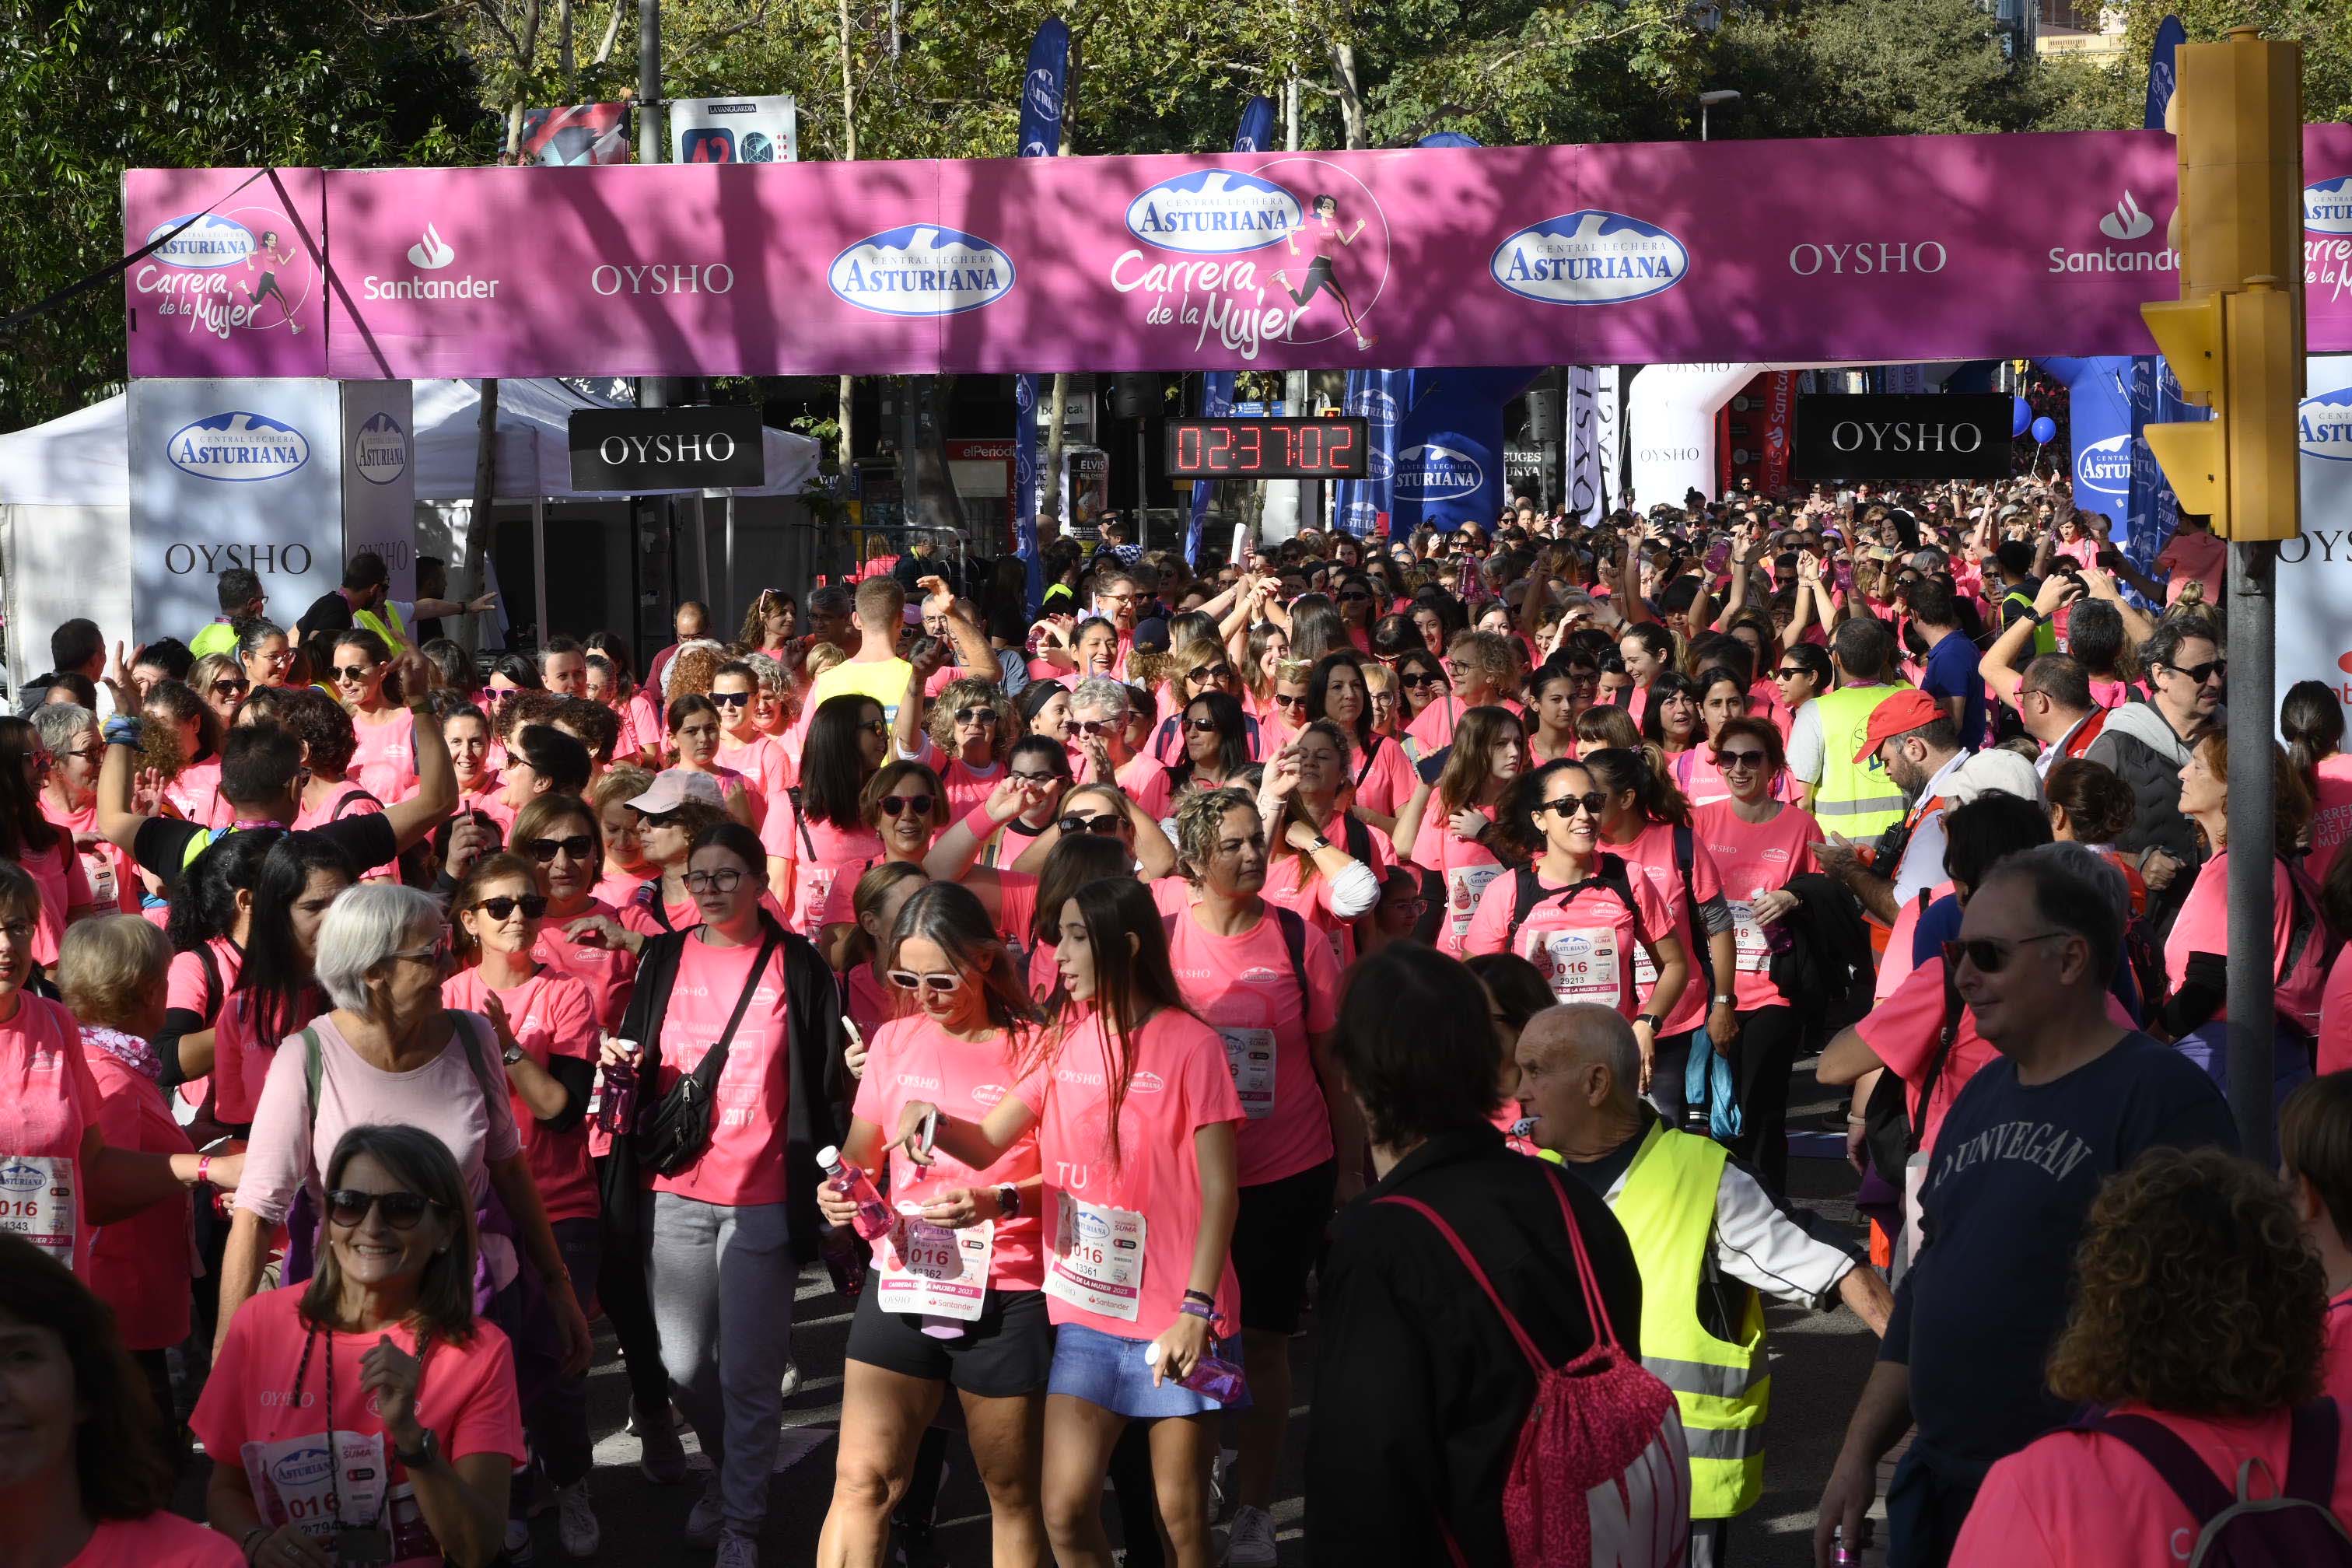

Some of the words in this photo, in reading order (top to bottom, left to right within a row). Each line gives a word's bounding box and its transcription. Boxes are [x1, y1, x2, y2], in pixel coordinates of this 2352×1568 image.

[1167, 197, 1222, 208] CENTRAL
[1227, 196, 1284, 207] LECHERA
[1139, 201, 1286, 233] ASTURIANA
[154, 233, 247, 255] ASTURIANA
[1536, 243, 1597, 253] CENTRAL
[1604, 242, 1667, 251] LECHERA
[871, 256, 929, 265] CENTRAL
[936, 254, 994, 264] LECHERA
[1505, 247, 1674, 281] ASTURIANA
[1789, 240, 1947, 275] OYSHO
[2048, 246, 2181, 274] Santande
[136, 264, 228, 294] Carrera
[590, 263, 735, 296] OYSHO
[843, 258, 1000, 292] ASTURIANA
[1111, 249, 1258, 293] Carrera
[363, 275, 499, 299] Santander
[159, 295, 177, 315] de
[180, 294, 191, 315] la
[189, 291, 262, 340] Mujer
[1146, 295, 1174, 325] de
[1179, 293, 1199, 325] la
[1195, 285, 1311, 360] Mujer
[1178, 426, 1353, 470] 02:37:02
[1832, 421, 1983, 453] OYSHO
[179, 437, 299, 464] ASTURIANA
[359, 439, 404, 467] ASTURIANA
[600, 432, 735, 465] OYSHO
[963, 445, 1017, 458] elPeriódi
[1640, 447, 1699, 462] OYSHO
[1080, 460, 1104, 470] ELVIS
[1395, 471, 1475, 487] STURIANA
[165, 543, 312, 575] OYSHO
[1734, 928, 1748, 938] 16
[1556, 961, 1588, 975] 016
[1560, 976, 1584, 985] 29213
[898, 1073, 939, 1090] OYSHO
[1058, 1069, 1102, 1086] OYSHO
[723, 1108, 754, 1125] 2019
[1056, 1160, 1087, 1189] TU
[1114, 1224, 1138, 1234] SUMA
[911, 1248, 950, 1266] 016
[1073, 1242, 1104, 1264] 016
[1076, 1262, 1097, 1277] 13361
[932, 1284, 957, 1293] MUJER
[957, 1286, 974, 1295] 2023
[1059, 1268, 1076, 1281] CARRERA
[1090, 1281, 1111, 1291] MUJER
[1113, 1286, 1129, 1295] 2023
[938, 1299, 975, 1311] Santander
[1096, 1297, 1130, 1311] Santander
[342, 1448, 373, 1460] SUMA
[289, 1492, 341, 1519] 016
